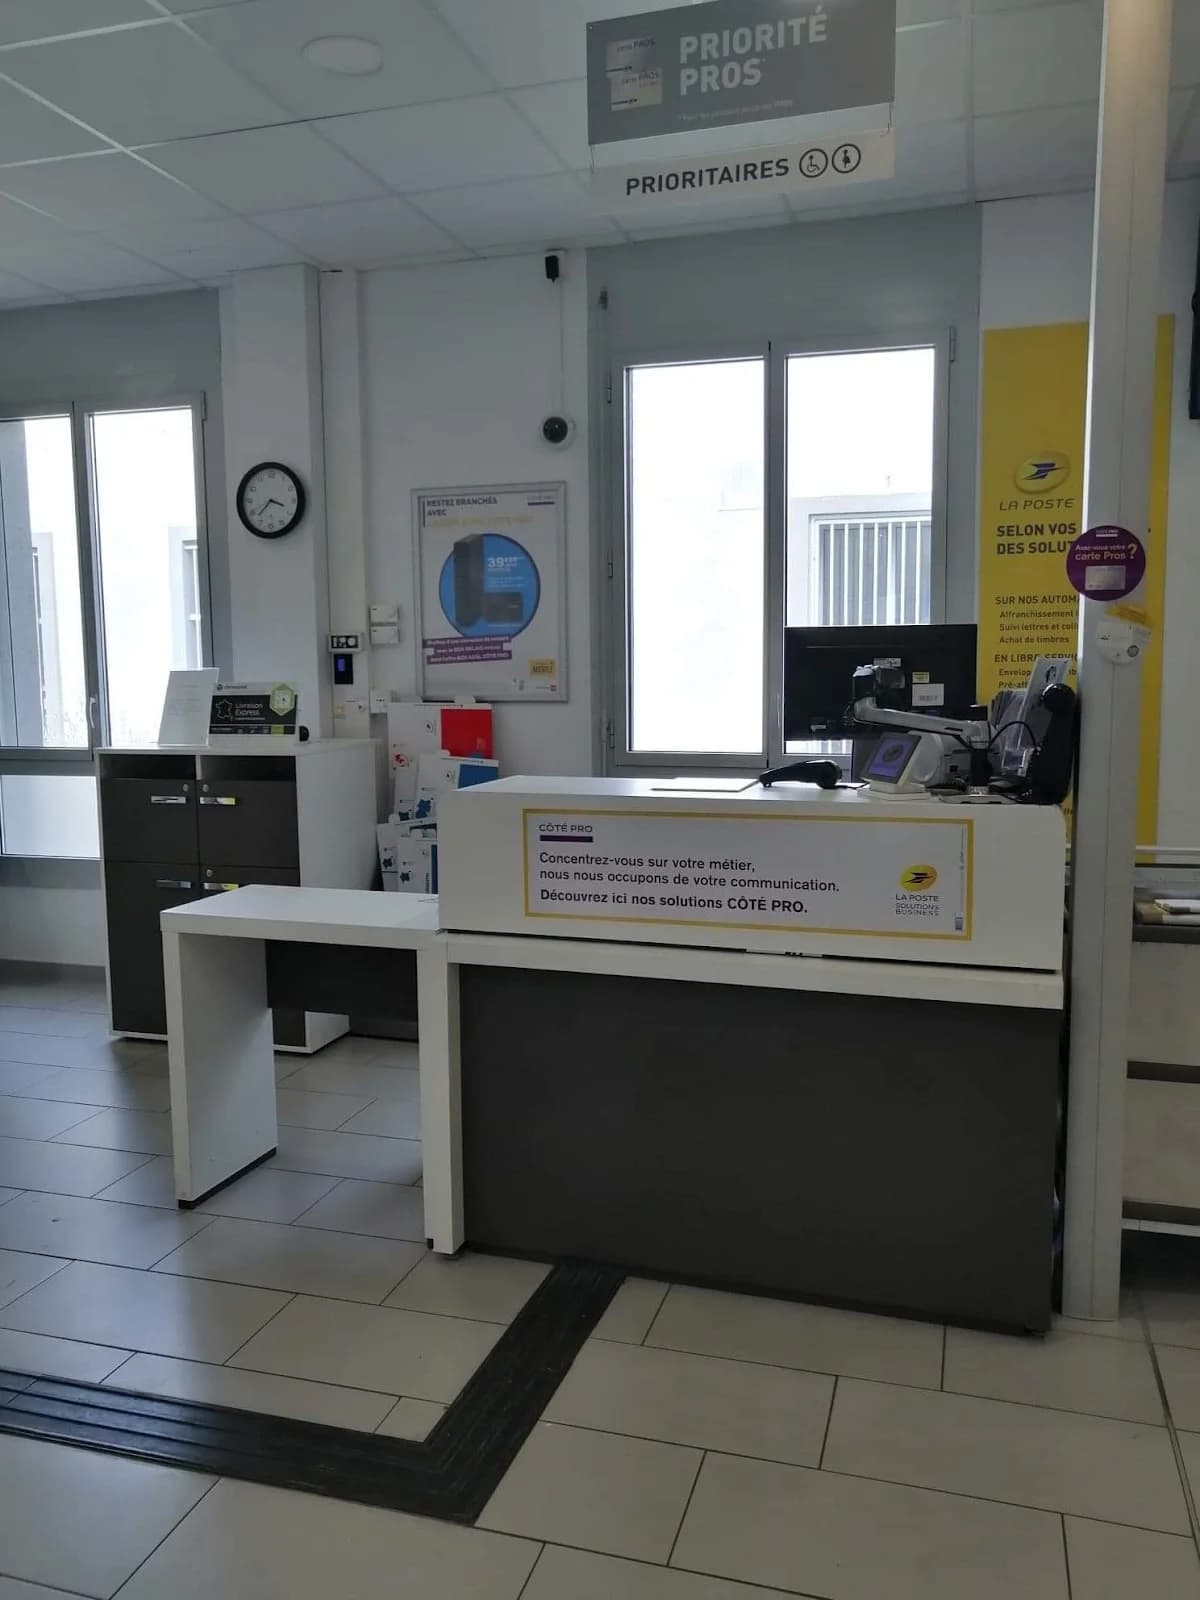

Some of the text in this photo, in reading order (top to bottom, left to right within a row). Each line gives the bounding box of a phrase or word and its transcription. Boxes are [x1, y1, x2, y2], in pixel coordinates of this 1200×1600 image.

[680, 3, 827, 64] PRIORITÉ
[626, 158, 790, 196] PRIORITAIRES
[999, 498, 1076, 511] LA POSTE
[996, 522, 1077, 538] SELON VOS
[997, 542, 1025, 555] DES
[1075, 551, 1101, 561] carte
[1103, 551, 1126, 561] Pros
[995, 596, 1015, 605] SUR
[1018, 595, 1038, 604] NOS
[999, 610, 1073, 618] Affranchissement
[999, 623, 1019, 632] Suivi
[1021, 622, 1049, 632] lettres
[1051, 622, 1060, 631] et
[999, 635, 1069, 644] Achat de timbres
[994, 654, 1008, 663] EN
[539, 823, 593, 833] CÔTÉ PRO
[539, 852, 756, 873] Concentrez-vous sur votre métier,
[539, 869, 840, 893] nous nous occupons de votre communication.
[540, 888, 809, 914] Découvrez ici nos solutions CÔTÉ PRO.
[895, 893, 941, 903] LA POSTE
[895, 902, 941, 911] SOLUTIONS
[895, 908, 941, 917] BUSINESS
